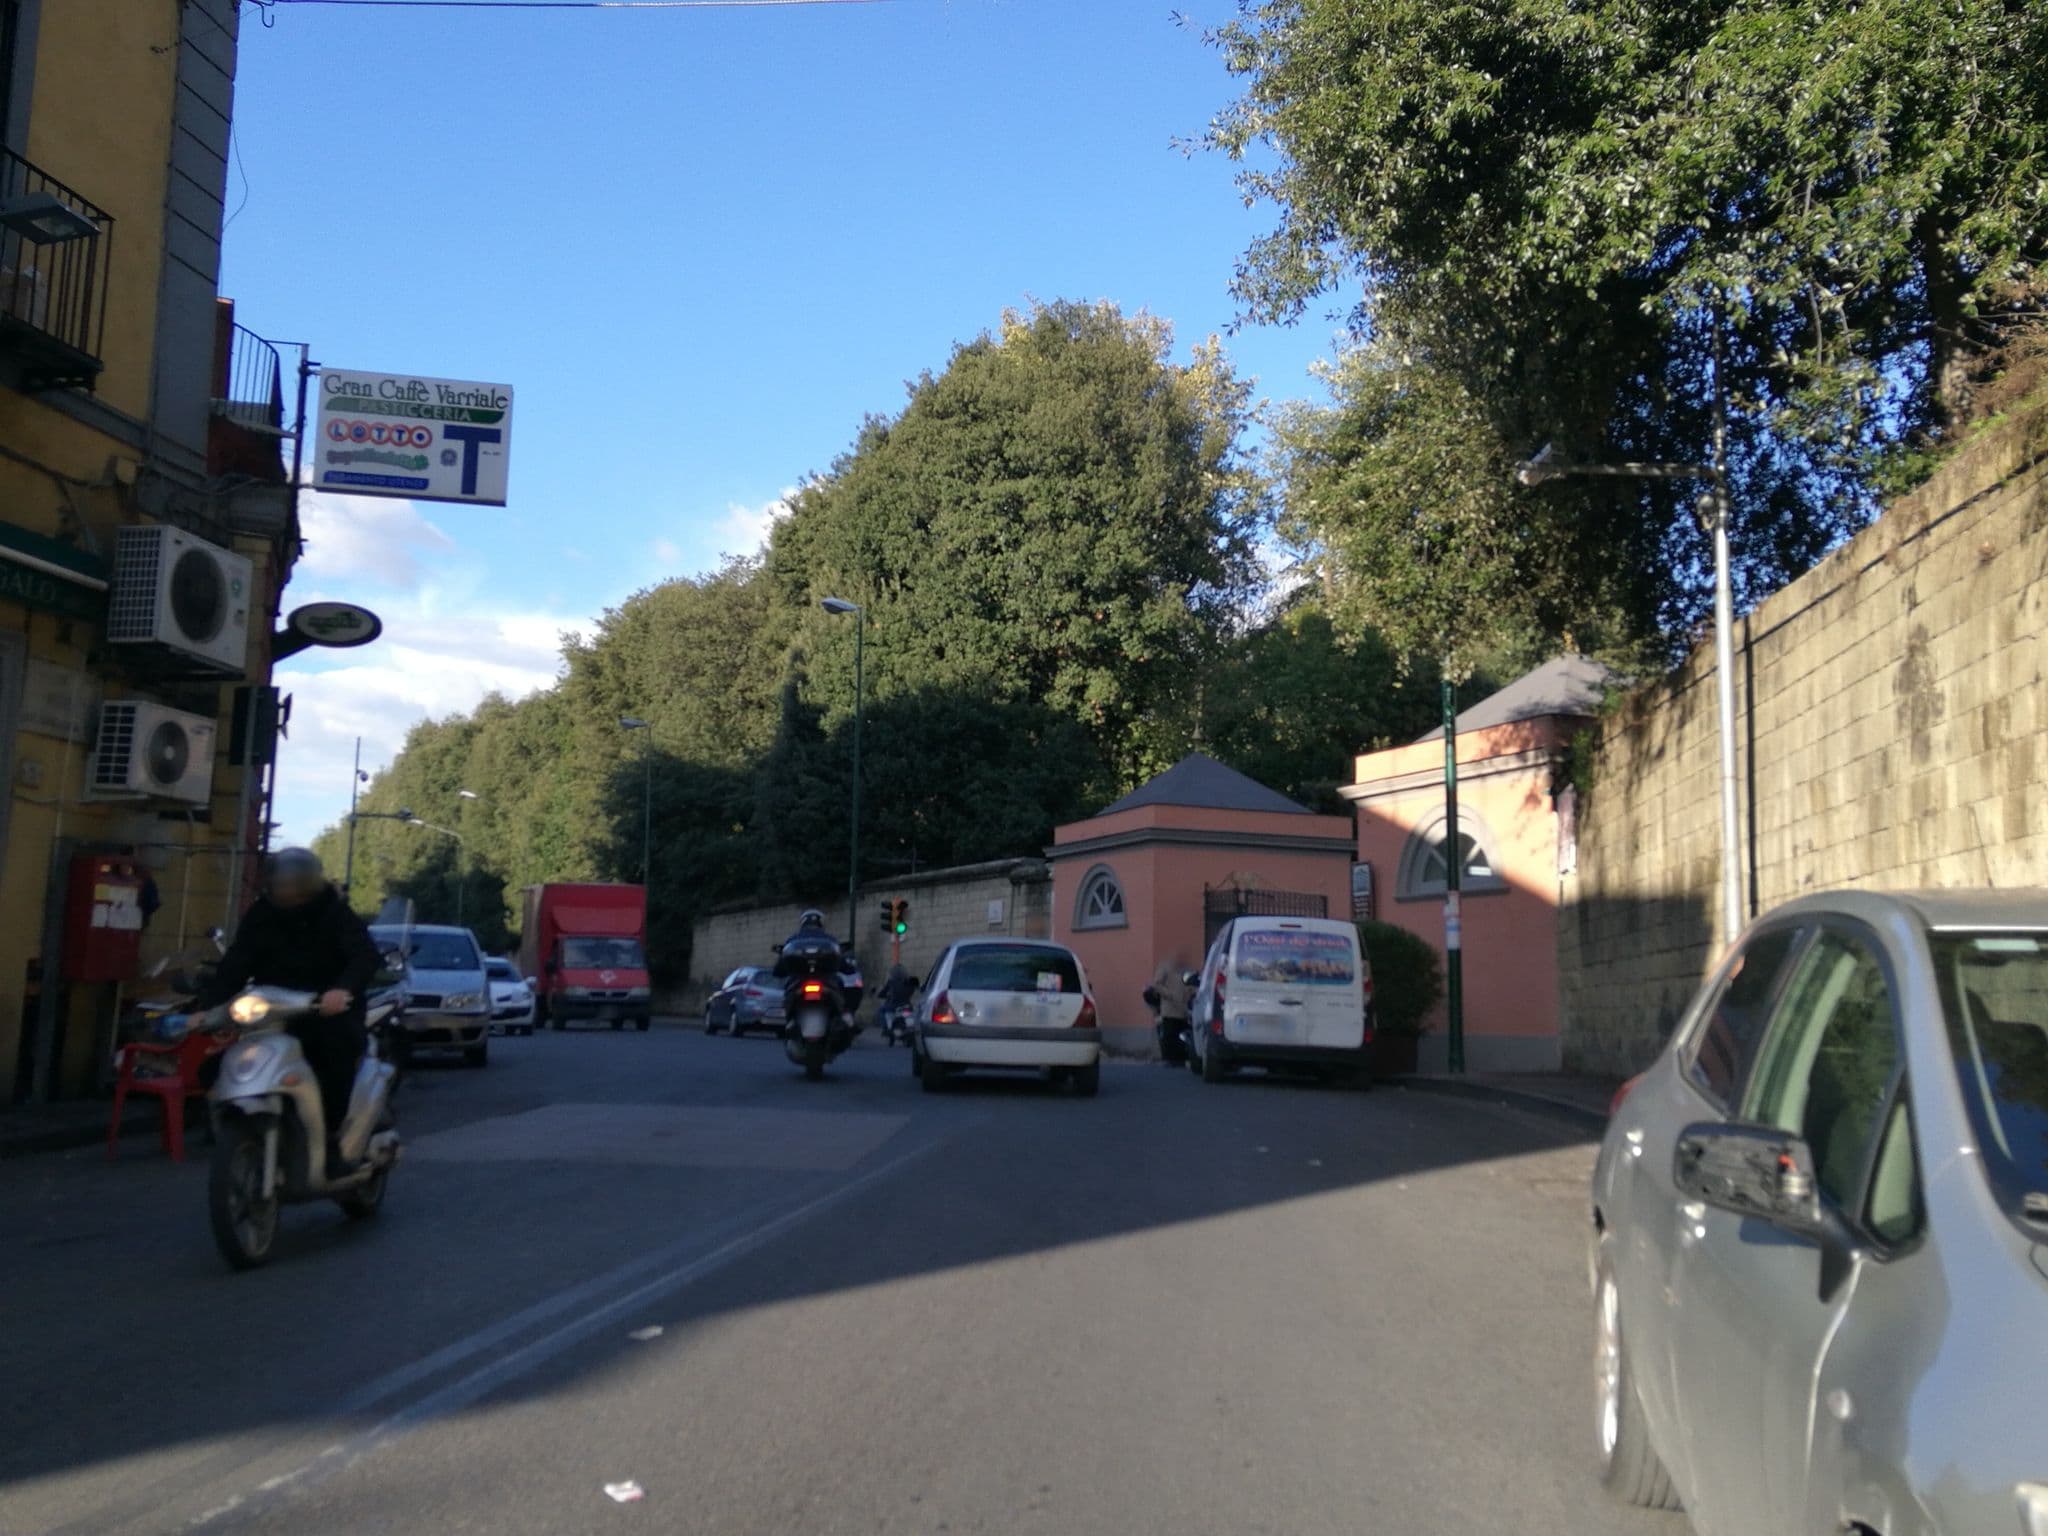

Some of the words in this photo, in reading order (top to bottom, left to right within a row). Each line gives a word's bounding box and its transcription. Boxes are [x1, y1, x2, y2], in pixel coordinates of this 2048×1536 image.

[324, 374, 373, 397] Gran
[379, 378, 430, 403] Caffè
[435, 384, 509, 410] Varriale
[359, 399, 471, 422] PASTICCERIA
[327, 418, 433, 449] LOTTO
